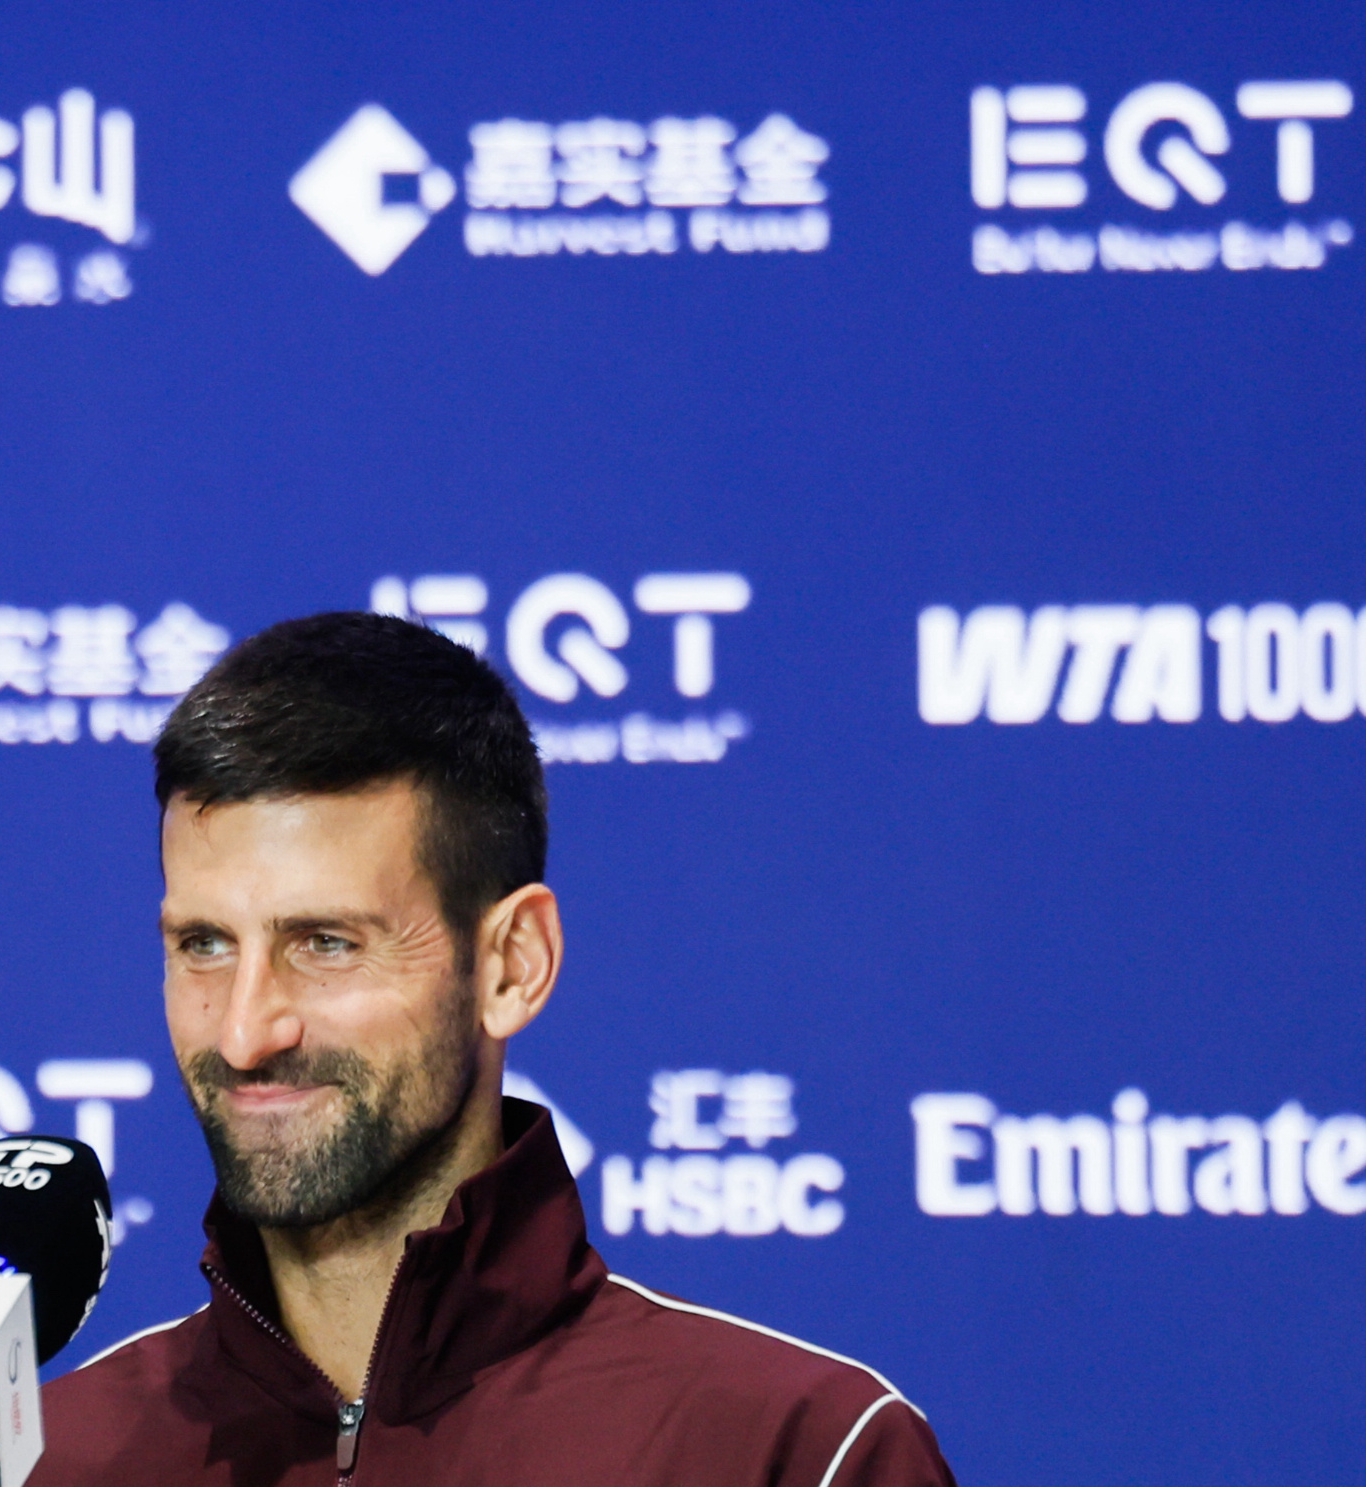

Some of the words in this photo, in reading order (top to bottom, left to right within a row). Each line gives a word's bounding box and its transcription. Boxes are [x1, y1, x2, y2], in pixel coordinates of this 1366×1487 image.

[466, 116, 828, 208] 嘉实基金
[971, 82, 1352, 210] EQT
[649, 1071, 795, 1150] 汇丰
[602, 1154, 844, 1237] HSBC
